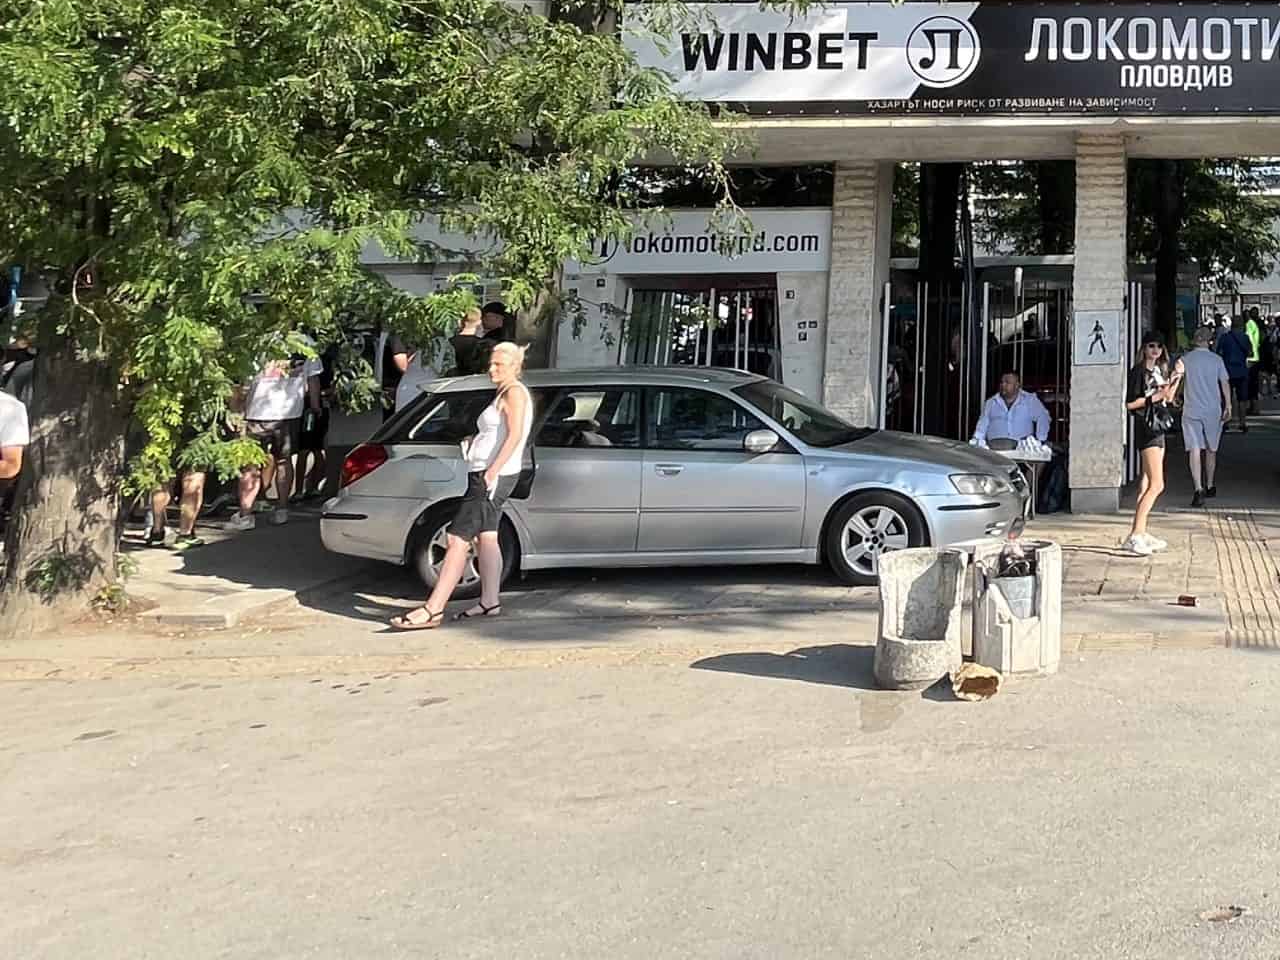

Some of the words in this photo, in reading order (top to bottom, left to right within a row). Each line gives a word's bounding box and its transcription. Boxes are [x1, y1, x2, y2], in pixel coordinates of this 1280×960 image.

[680, 30, 879, 72] WINBET
[1119, 64, 1234, 91] ПЛОВДИВ
[923, 98, 954, 109] НОСИ
[957, 98, 986, 109] РИСК
[988, 98, 1002, 109] ОТ
[1004, 97, 1066, 108] РАЗВИВАНЕ
[1068, 97, 1084, 107] НА
[1086, 97, 1158, 107] ЗАВИСИМОСТ
